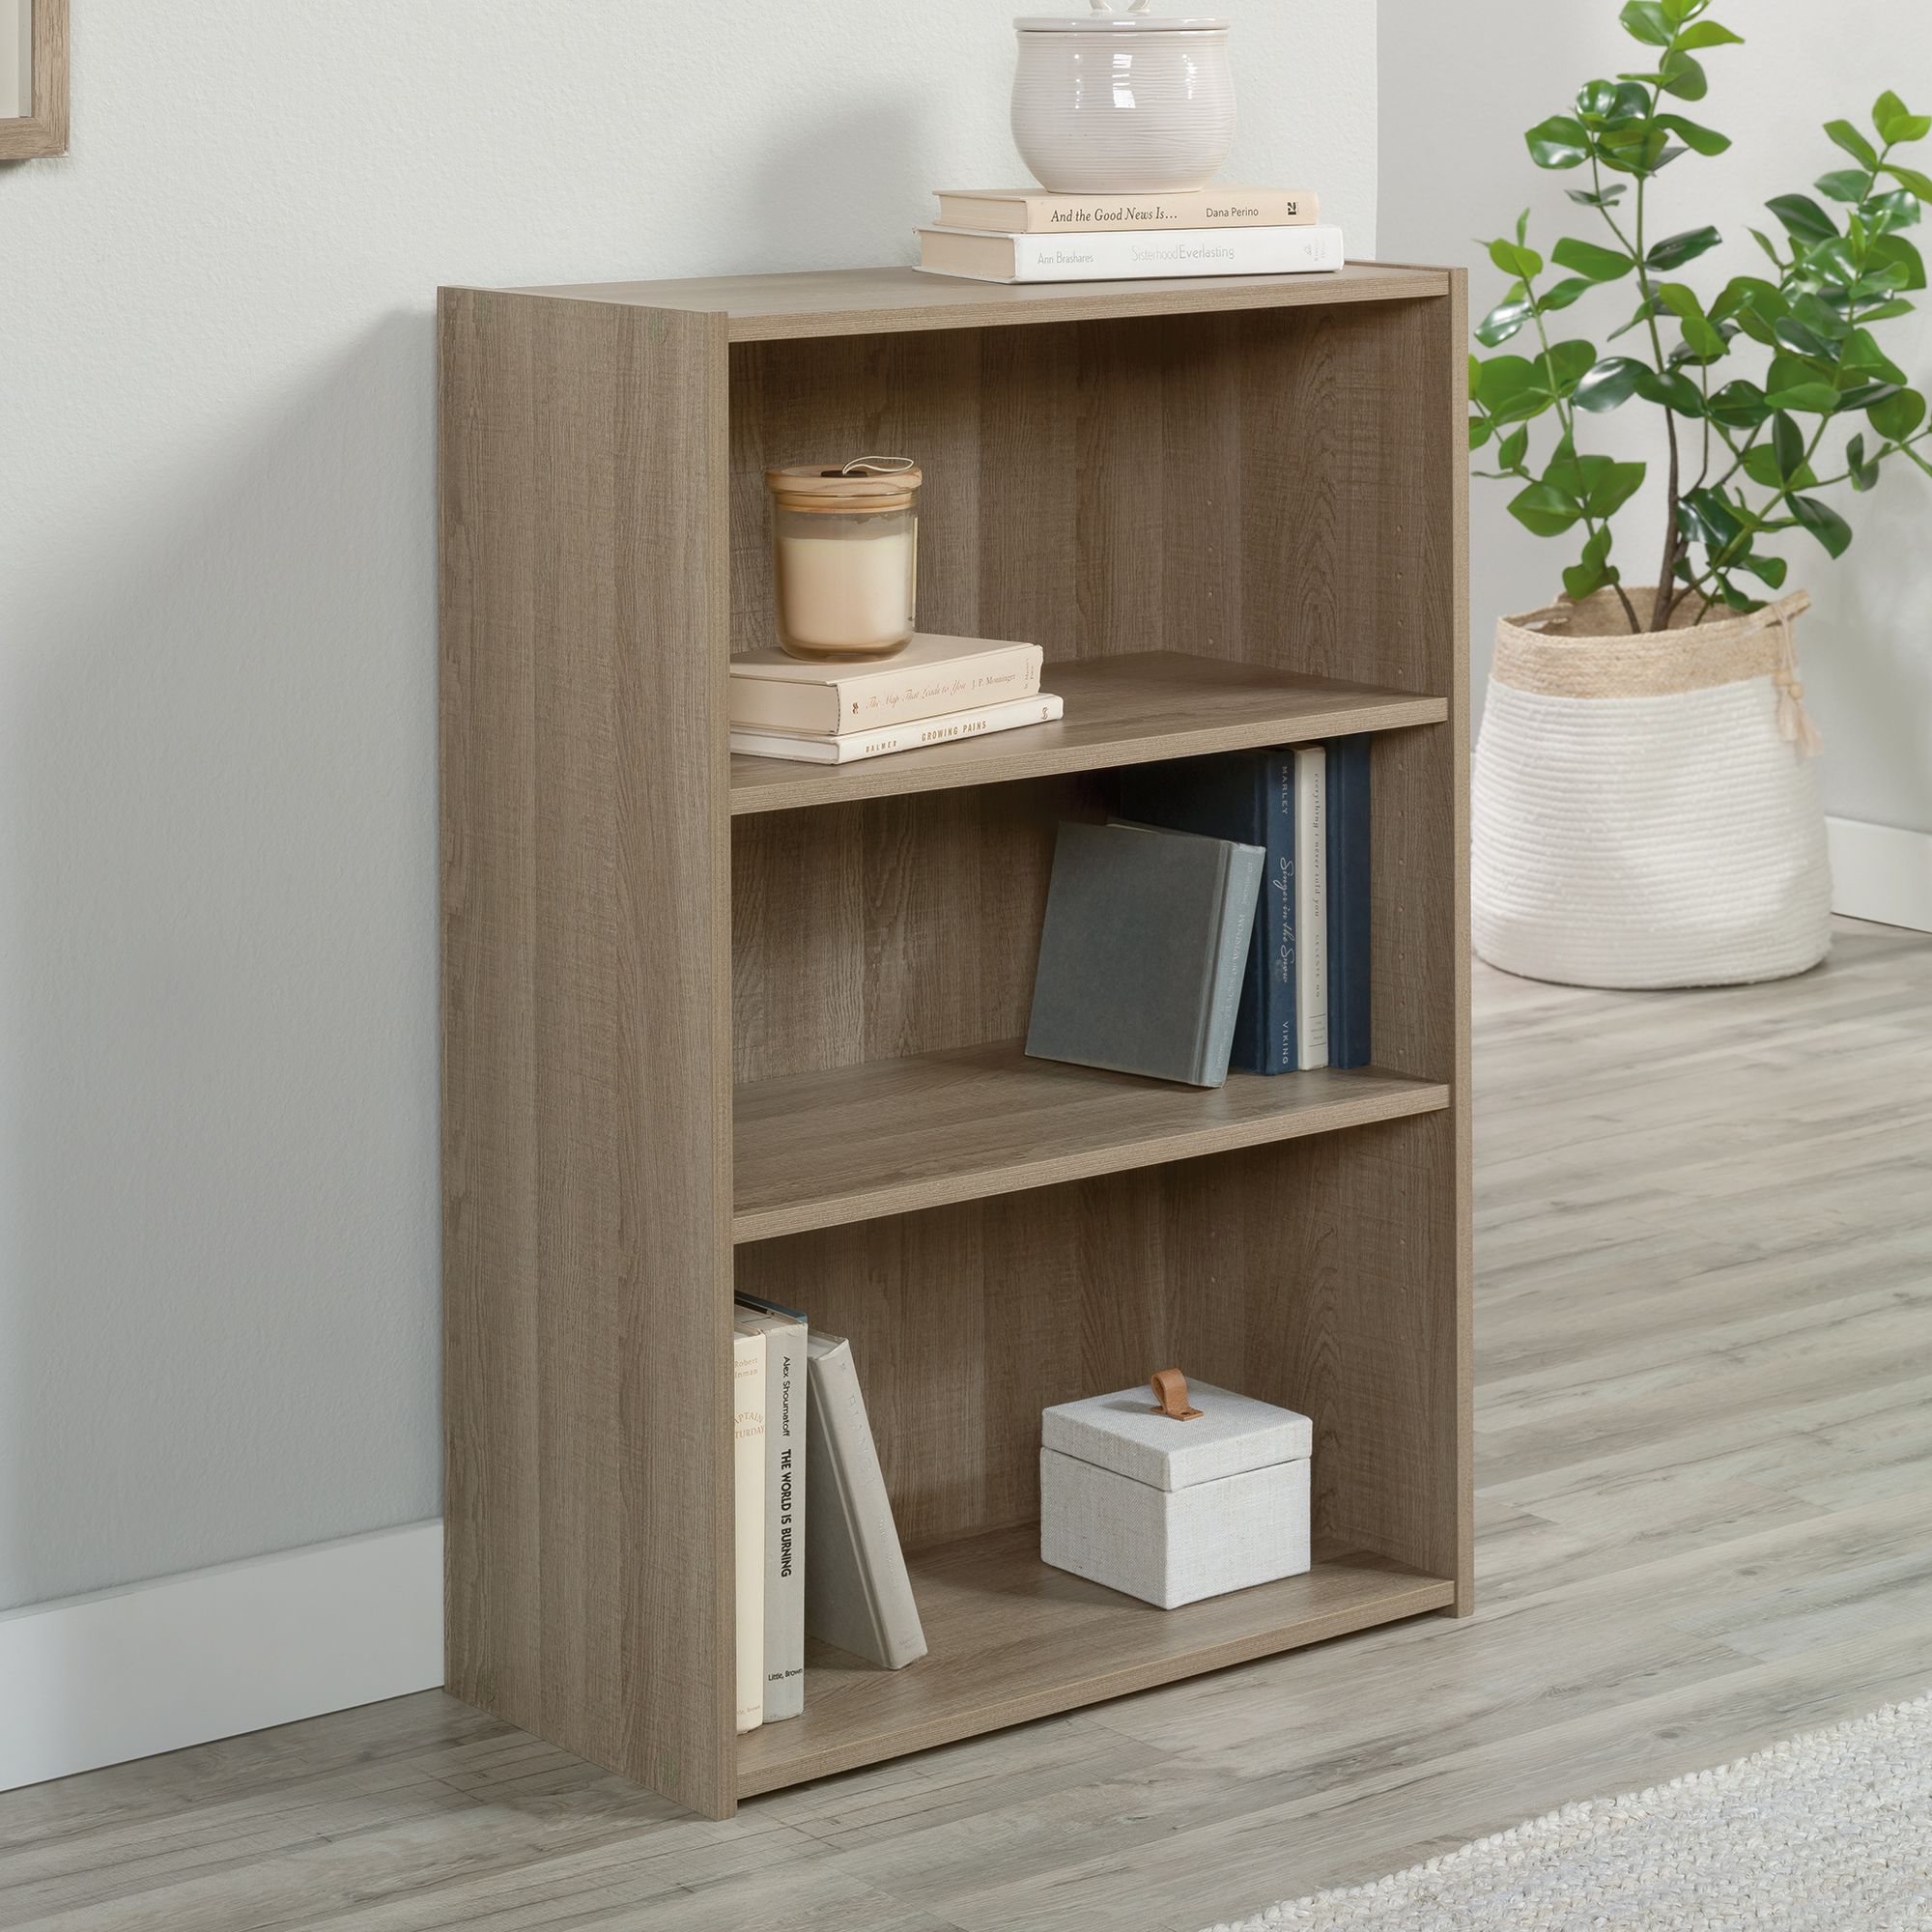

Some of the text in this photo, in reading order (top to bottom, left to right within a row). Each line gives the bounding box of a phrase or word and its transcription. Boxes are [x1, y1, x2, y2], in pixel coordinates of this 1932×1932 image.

[1050, 210, 1072, 222] And
[1075, 209, 1091, 222] the
[1094, 208, 1122, 222] Good
[1124, 207, 1153, 220] News
[1206, 207, 1260, 218] Dana Perino
[1037, 250, 1094, 264] Ann Brashares
[921, 720, 987, 742] GROWING PAINS
[866, 740, 897, 753] BALMER
[1312, 773, 1321, 829] everything
[1272, 857, 1295, 982] Singer in the Snow
[734, 1357, 758, 1369] Robert
[781, 1356, 791, 1436] Alex Shoumatoff
[734, 1410, 765, 1425] APTAIN
[734, 1425, 765, 1439] TURDAY
[781, 1449, 791, 1577] THE WORLD IS BURNING
[785, 1667, 803, 1678] Brown
